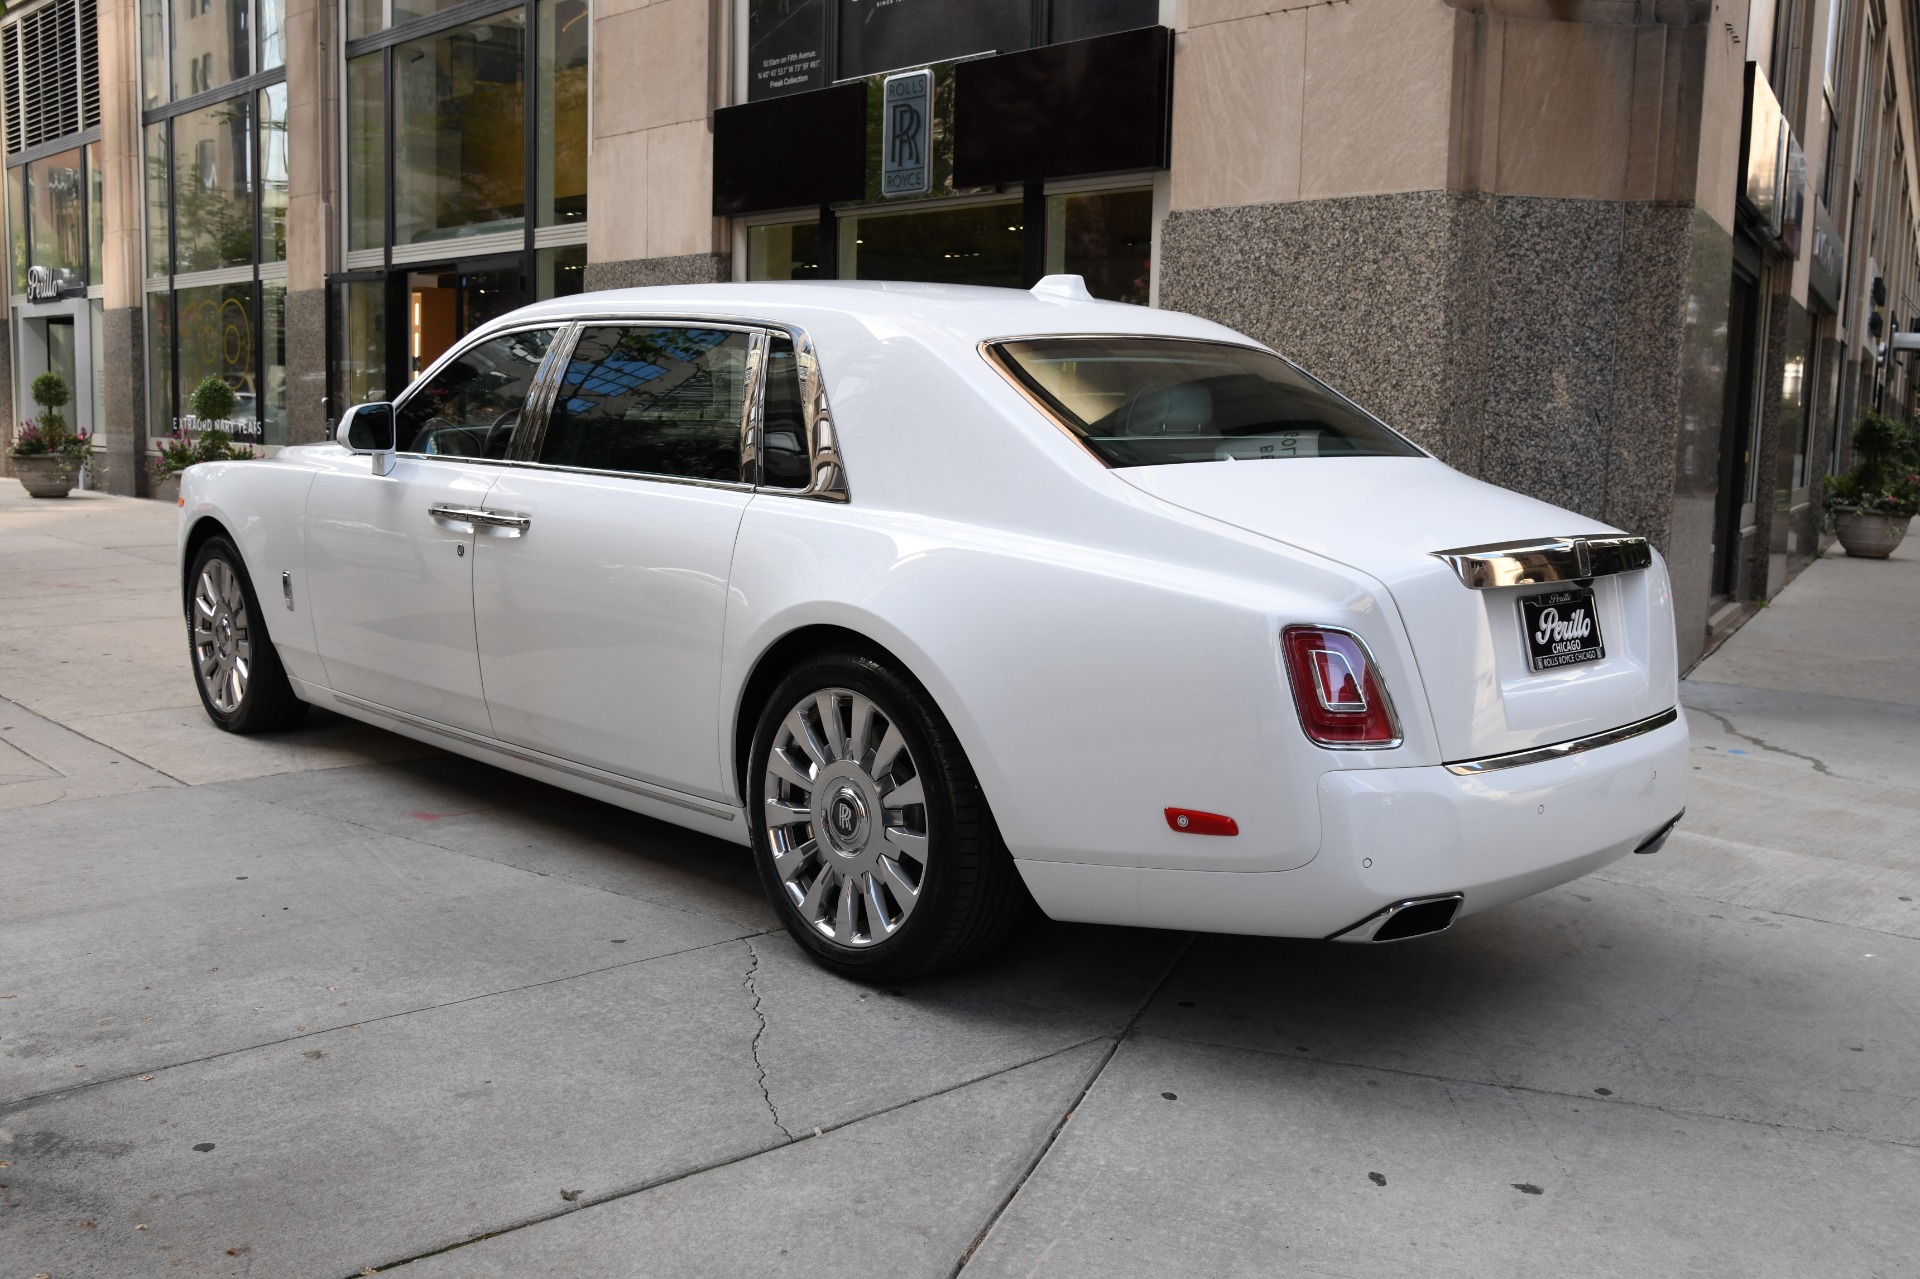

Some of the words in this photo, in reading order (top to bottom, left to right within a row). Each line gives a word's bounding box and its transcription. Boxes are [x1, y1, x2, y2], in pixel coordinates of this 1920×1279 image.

[788, 53, 798, 62] Fifth
[770, 80, 783, 88] Freak
[784, 75, 809, 85] Collection
[889, 80, 924, 97] ROLLS
[887, 172, 922, 188] ROYCE
[28, 267, 58, 300] Perillo
[173, 417, 235, 433] EXTRAORDNARY
[1535, 608, 1591, 645] Perillo
[1552, 639, 1581, 654] CHICAGO
[1543, 656, 1558, 667] ROLLS
[1558, 653, 1575, 665] ROYCE
[1575, 650, 1596, 662] CHICAGO
